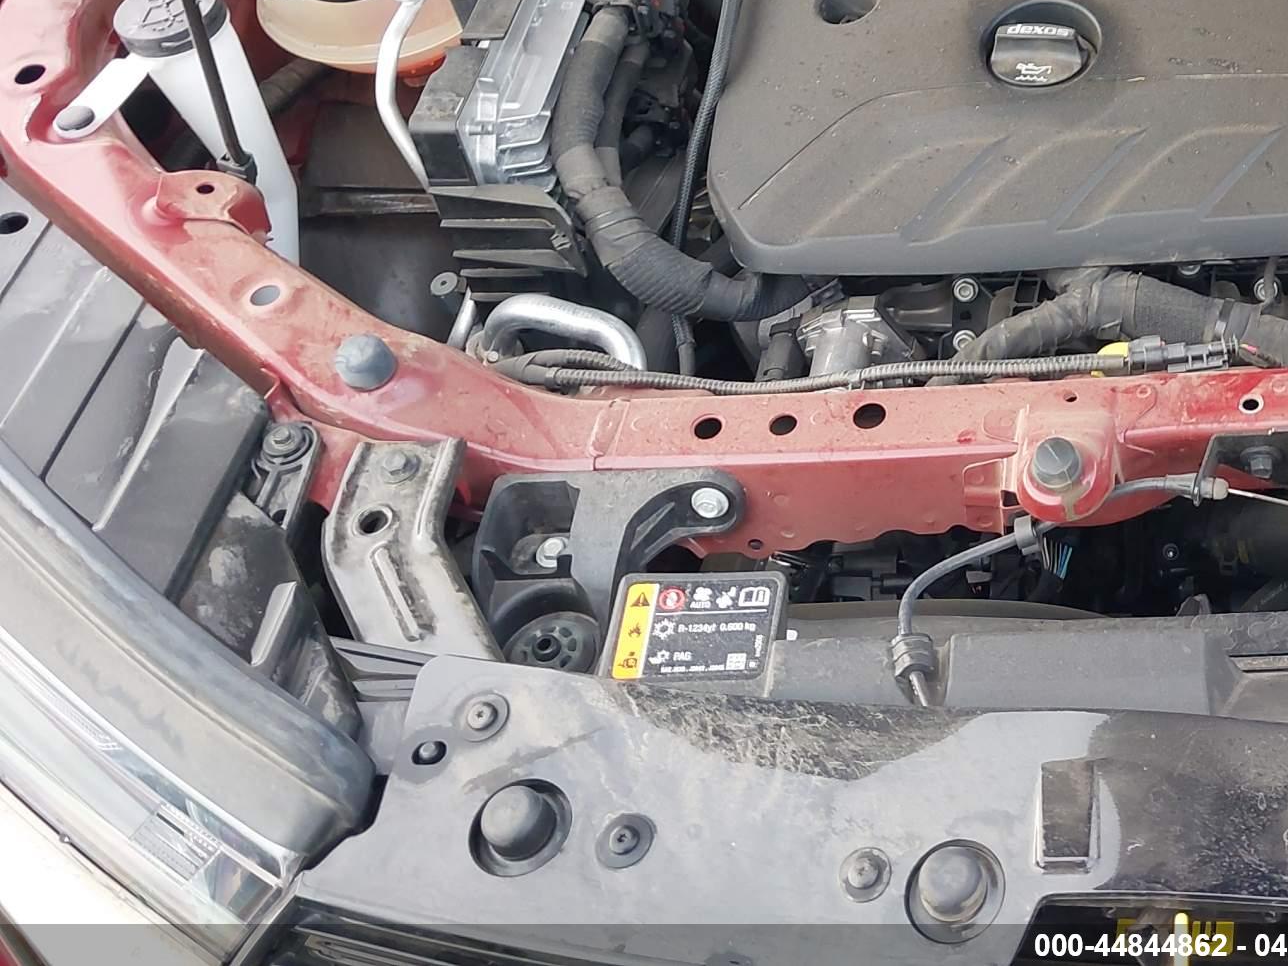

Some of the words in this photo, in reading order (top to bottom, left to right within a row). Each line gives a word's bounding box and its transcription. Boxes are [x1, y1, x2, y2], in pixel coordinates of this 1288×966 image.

[1007, 23, 1070, 37] dexos
[689, 600, 711, 609] AUTO
[673, 652, 692, 661] PAG
